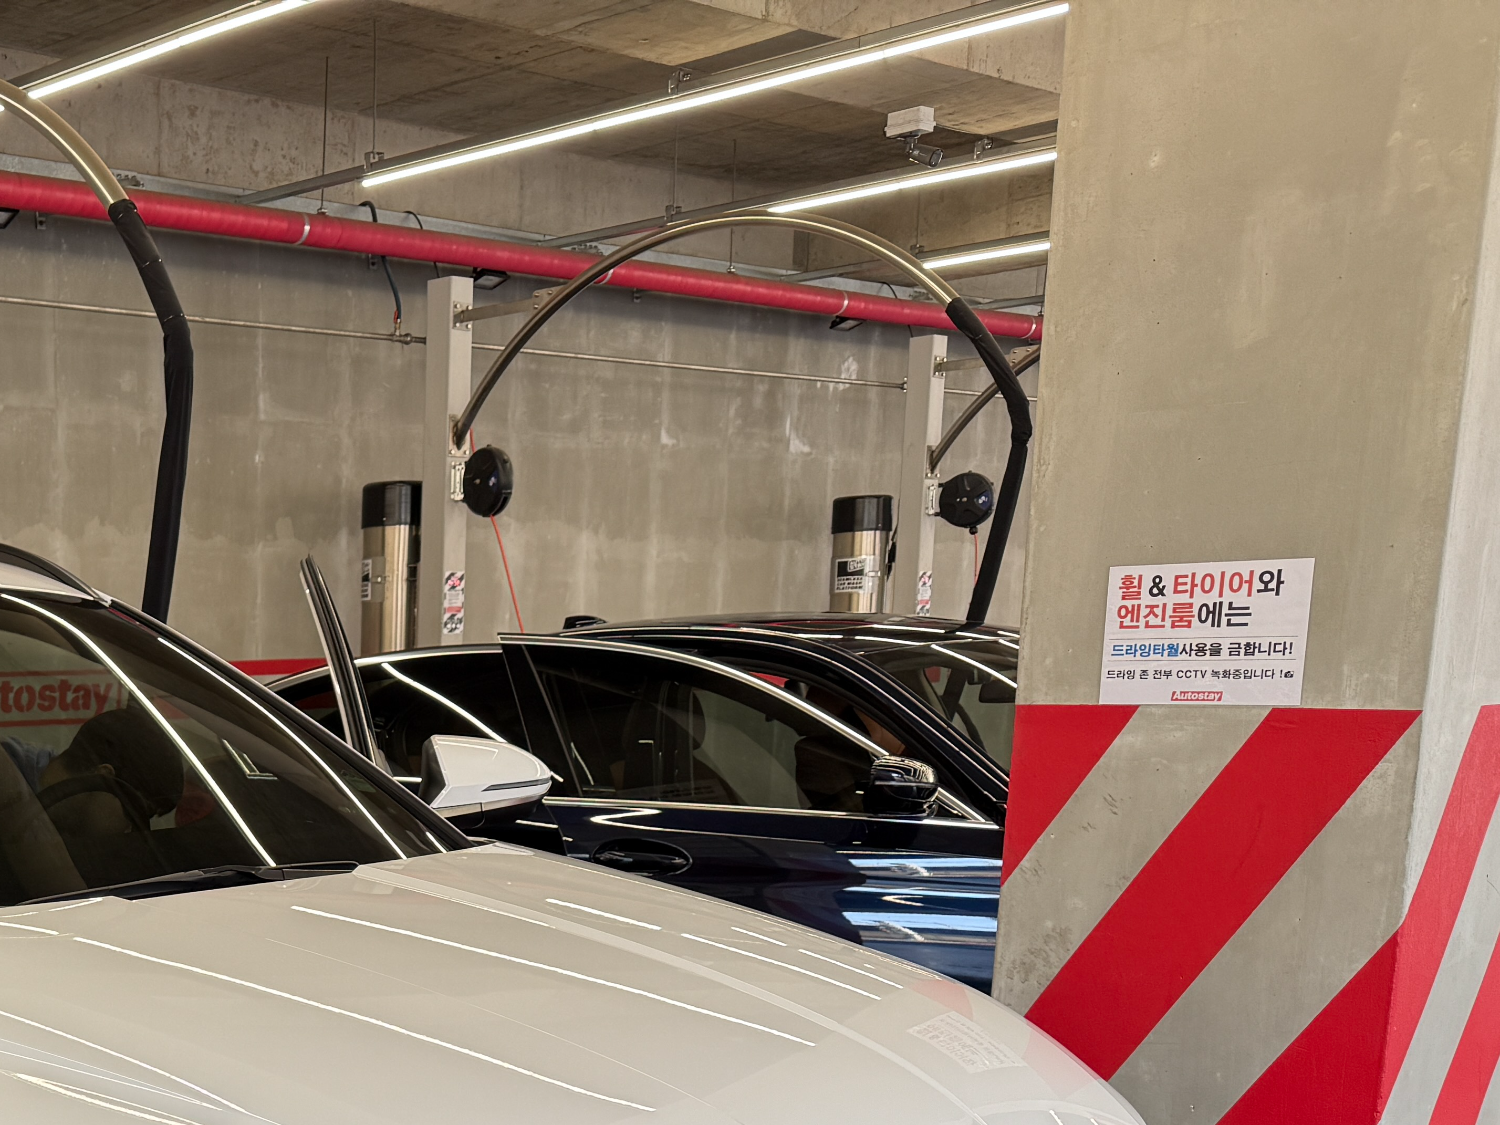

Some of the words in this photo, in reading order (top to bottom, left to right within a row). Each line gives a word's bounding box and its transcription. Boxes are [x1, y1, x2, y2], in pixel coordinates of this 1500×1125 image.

[1116, 601, 1252, 630] 엔진룸에는
[1227, 641, 1294, 657] 금합니다!
[1105, 669, 1136, 680] 드라잉
[1139, 669, 1150, 680] 존
[1152, 669, 1173, 680] 전부
[1176, 669, 1208, 679] CCTV
[1172, 690, 1222, 702] Autostay
